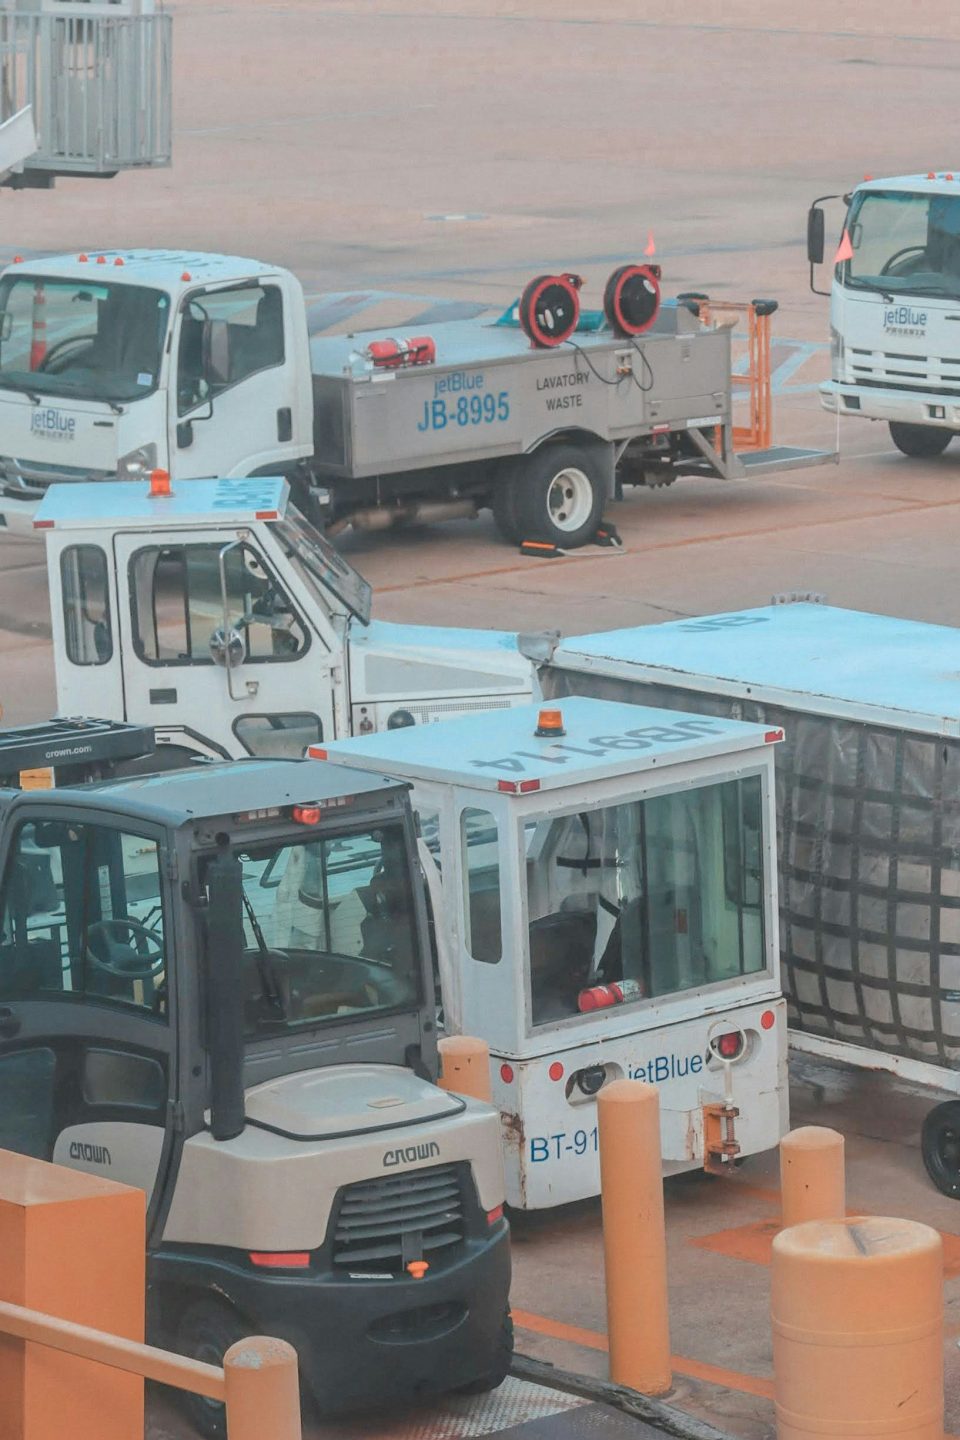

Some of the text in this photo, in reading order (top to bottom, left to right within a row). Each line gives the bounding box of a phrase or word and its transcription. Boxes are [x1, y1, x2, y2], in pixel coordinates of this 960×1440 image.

[883, 306, 927, 327] jetBlue
[434, 372, 484, 398] jetBlue
[536, 371, 590, 391] LAVATORY
[417, 391, 510, 432] JB-8995
[545, 395, 582, 411] WASTE
[30, 409, 76, 432] jetBlue
[45, 745, 92, 759] crown.com
[627, 1054, 703, 1083] jetBlue
